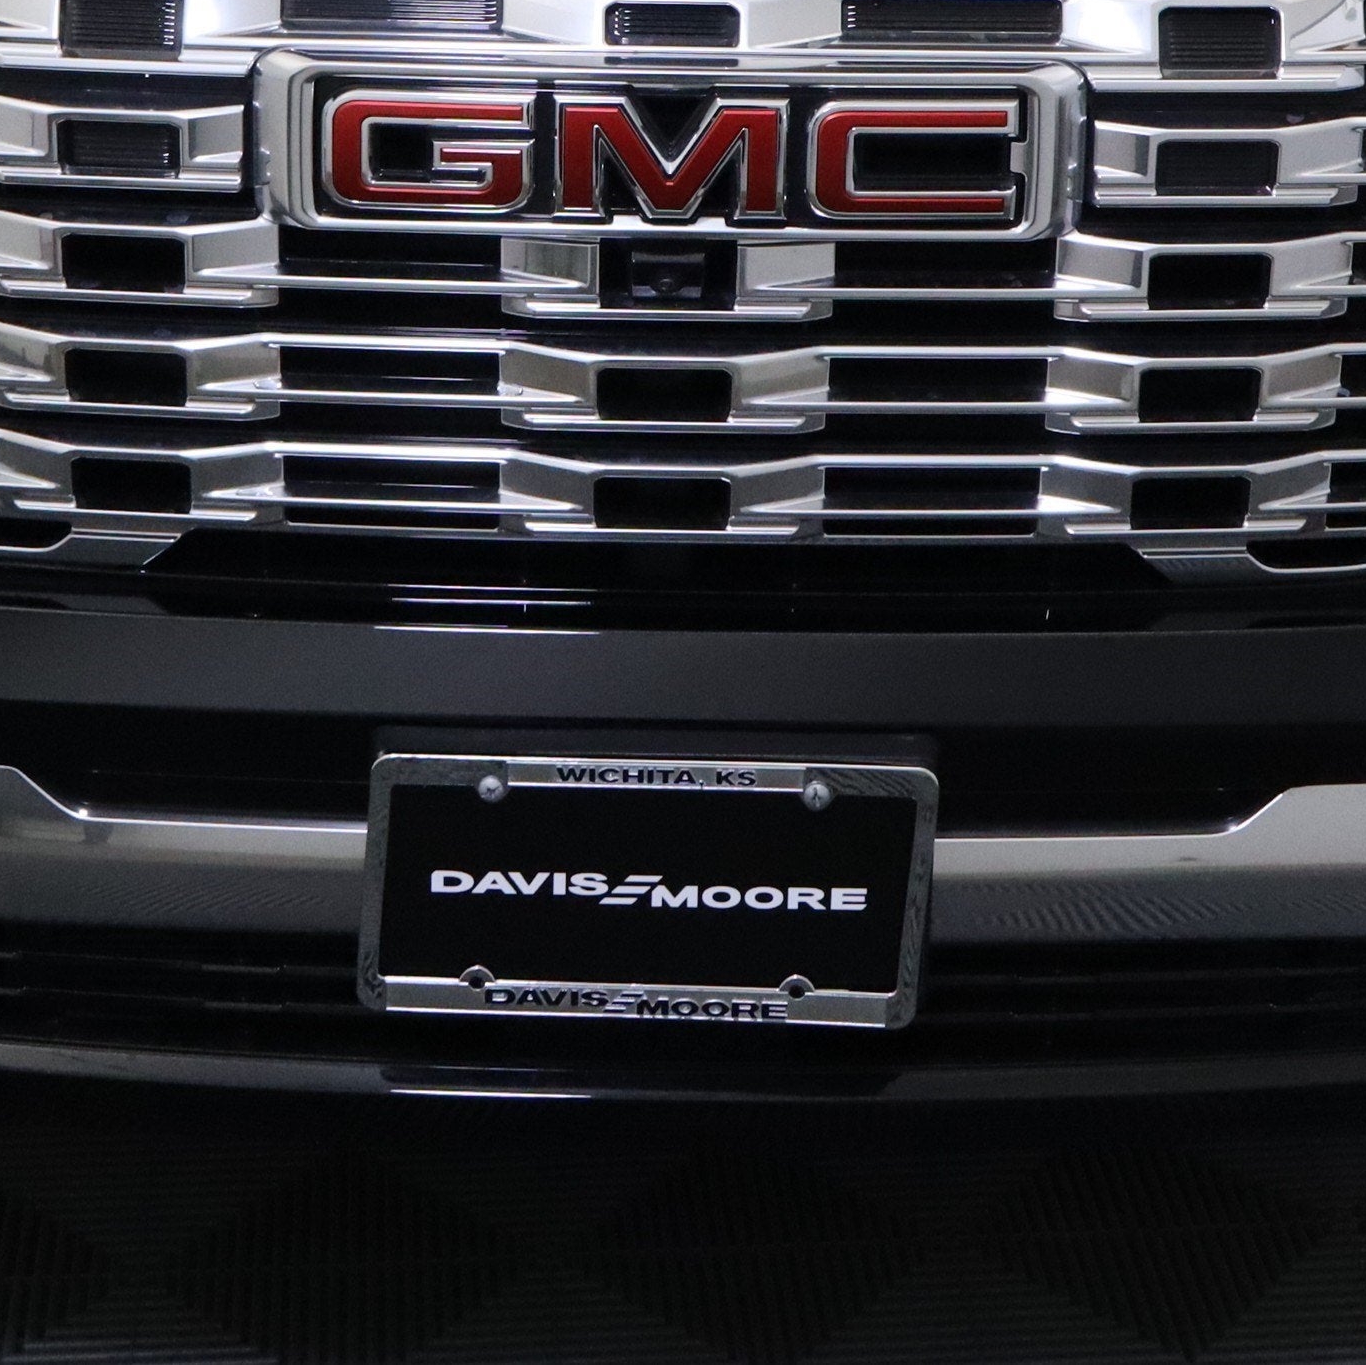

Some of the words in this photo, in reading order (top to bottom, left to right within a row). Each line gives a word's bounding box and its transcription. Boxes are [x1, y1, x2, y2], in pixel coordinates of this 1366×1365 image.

[321, 88, 1019, 221] GMC
[716, 769, 756, 786] KS
[431, 870, 608, 896] DAVIS
[651, 885, 867, 910] MOORE
[485, 989, 609, 1006] DAVIS
[636, 999, 788, 1019] MOORE
